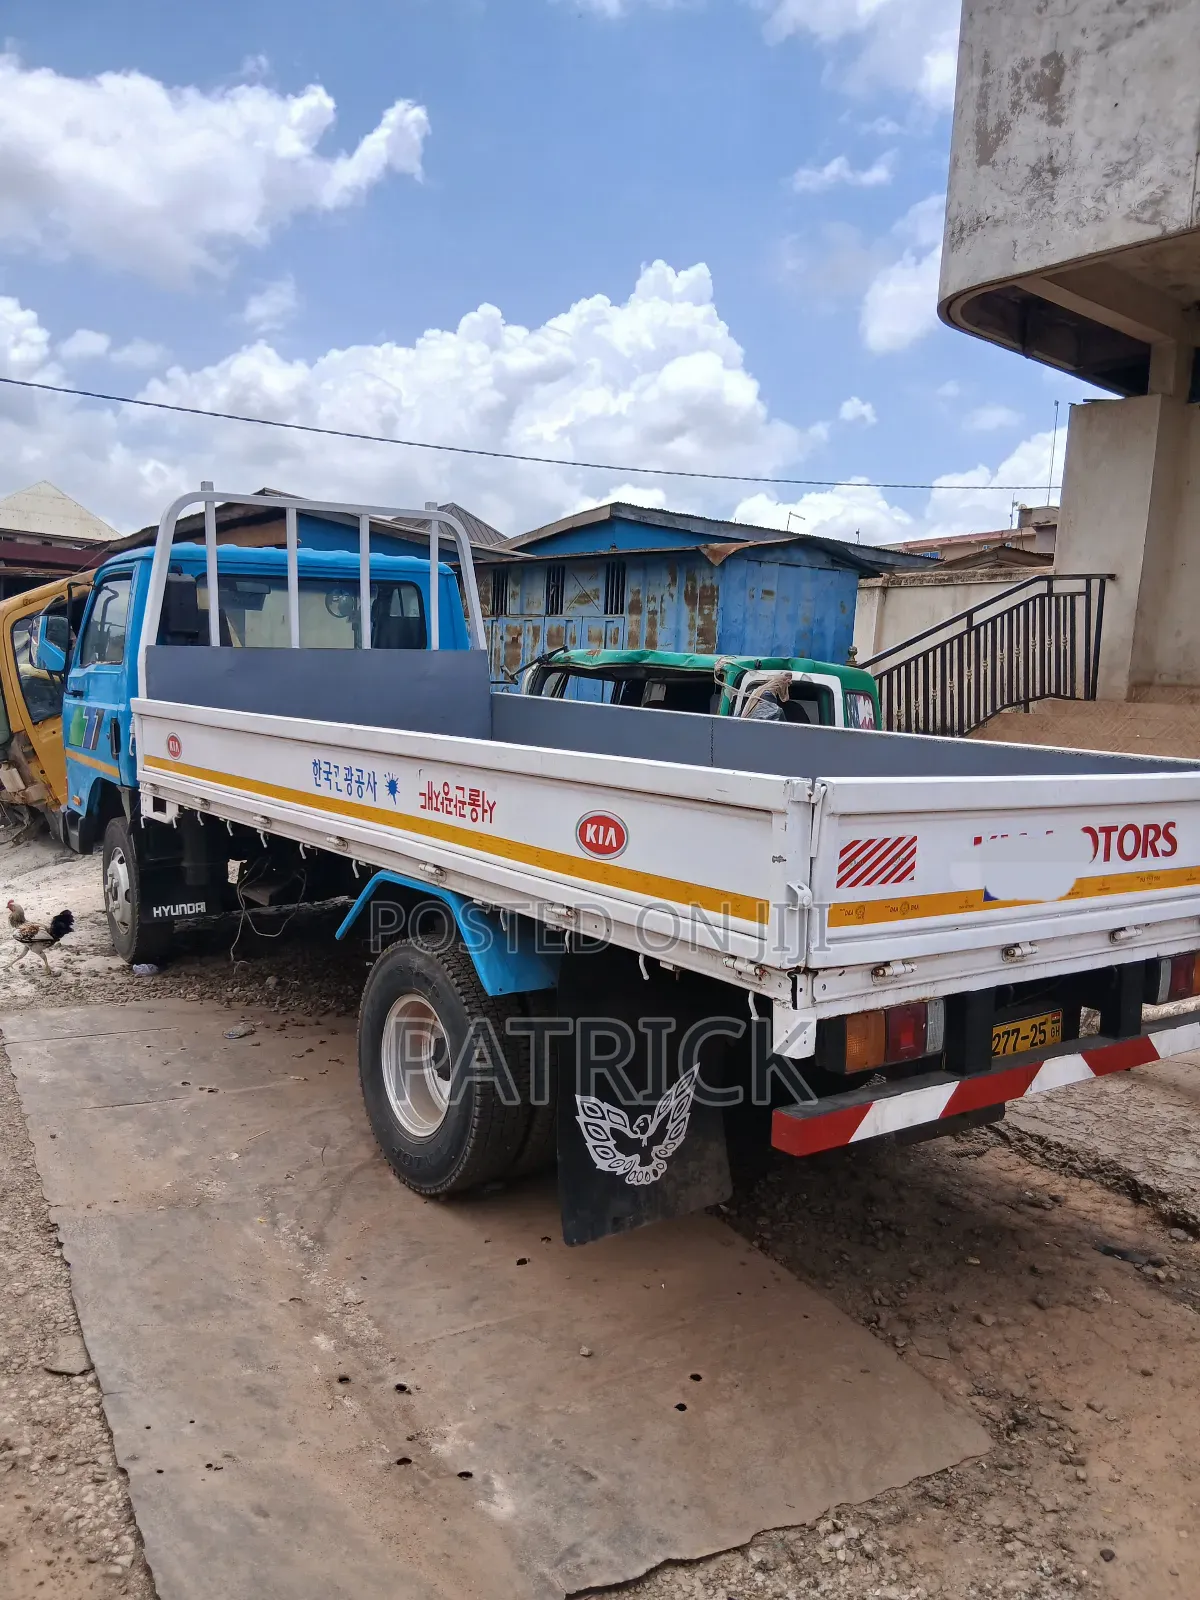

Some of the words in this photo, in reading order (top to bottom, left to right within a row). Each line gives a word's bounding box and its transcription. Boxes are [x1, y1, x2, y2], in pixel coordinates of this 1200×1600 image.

[585, 823, 617, 848] KIA
[152, 901, 207, 918] HYUNDAI
[1050, 1026, 1060, 1038] GH
